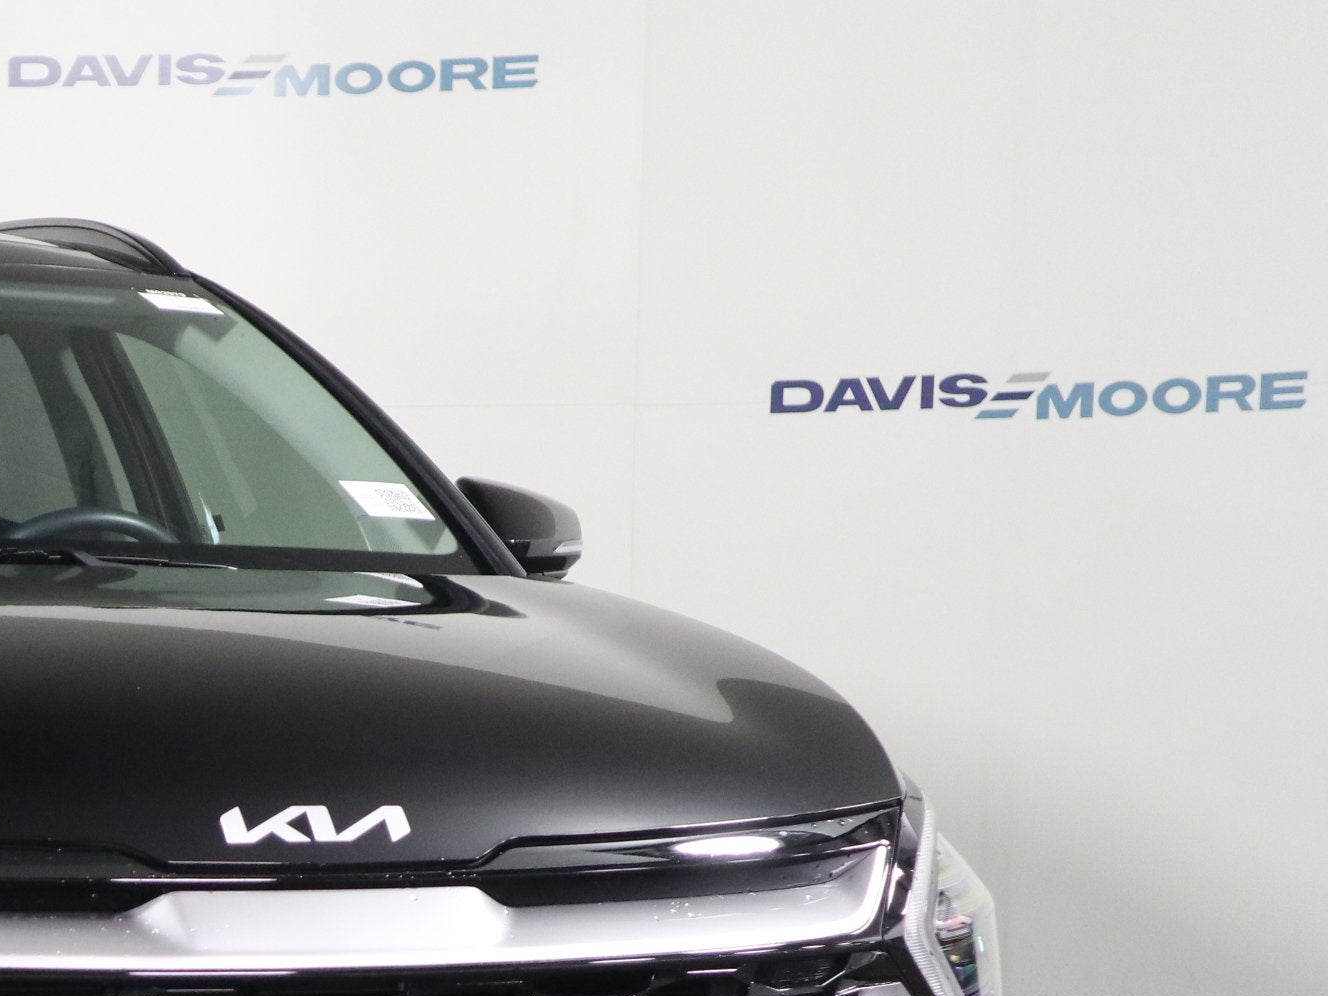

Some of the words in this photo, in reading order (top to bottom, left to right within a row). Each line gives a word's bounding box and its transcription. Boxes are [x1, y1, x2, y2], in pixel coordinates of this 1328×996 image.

[8, 52, 227, 87] DAVIS
[274, 54, 539, 97] MOORE
[770, 373, 988, 414] DAVIS
[1036, 371, 1308, 420] MOORE
[220, 805, 411, 844] KIA
